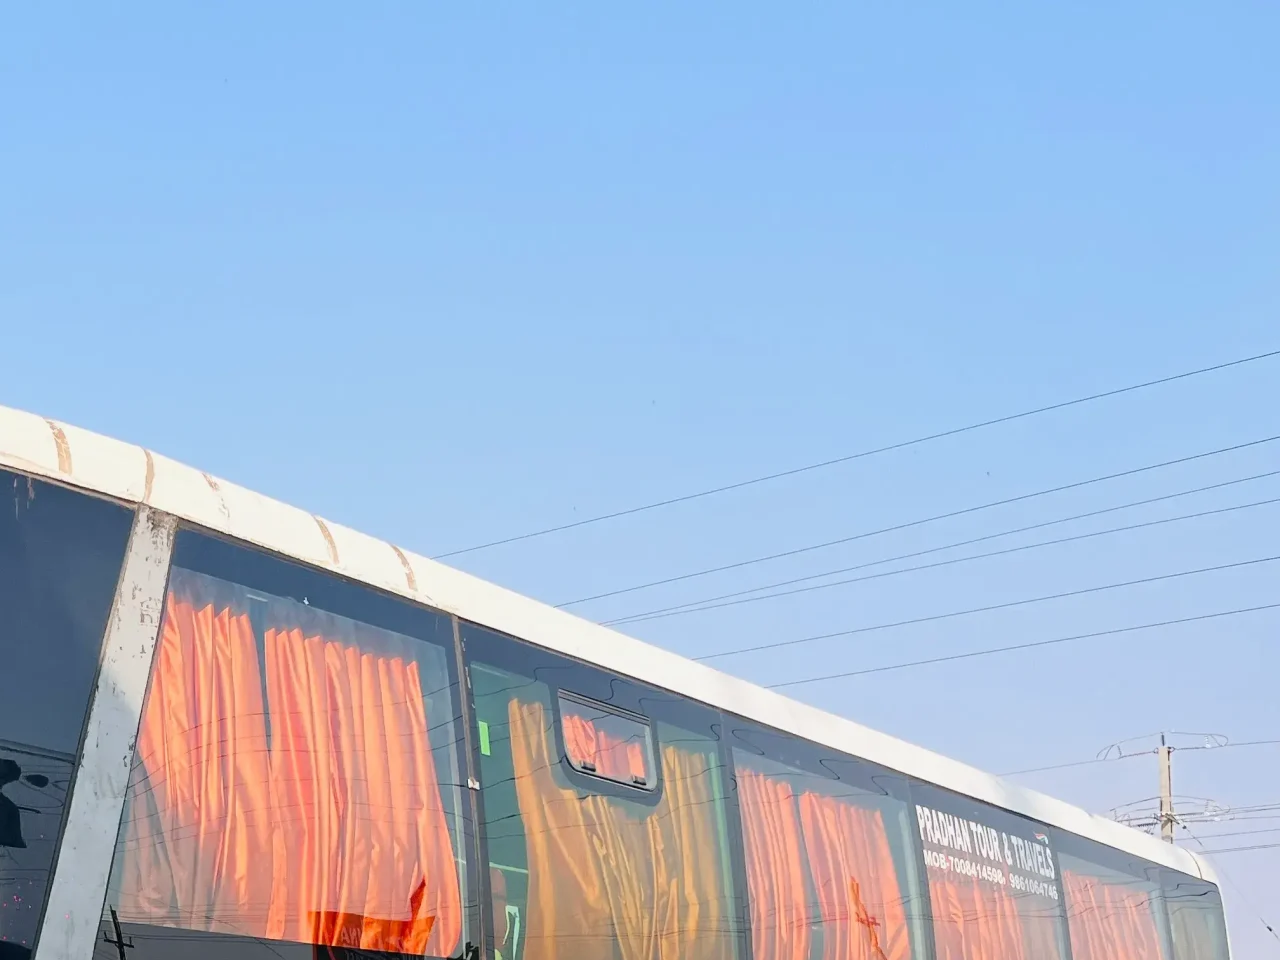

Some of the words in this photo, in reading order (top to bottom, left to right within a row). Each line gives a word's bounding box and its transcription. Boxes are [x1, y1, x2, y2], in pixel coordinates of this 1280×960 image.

[915, 804, 972, 854] PRADHAN
[969, 820, 1003, 863] TOUR
[1002, 832, 1013, 866] &
[1010, 835, 1056, 880] TRAVELS
